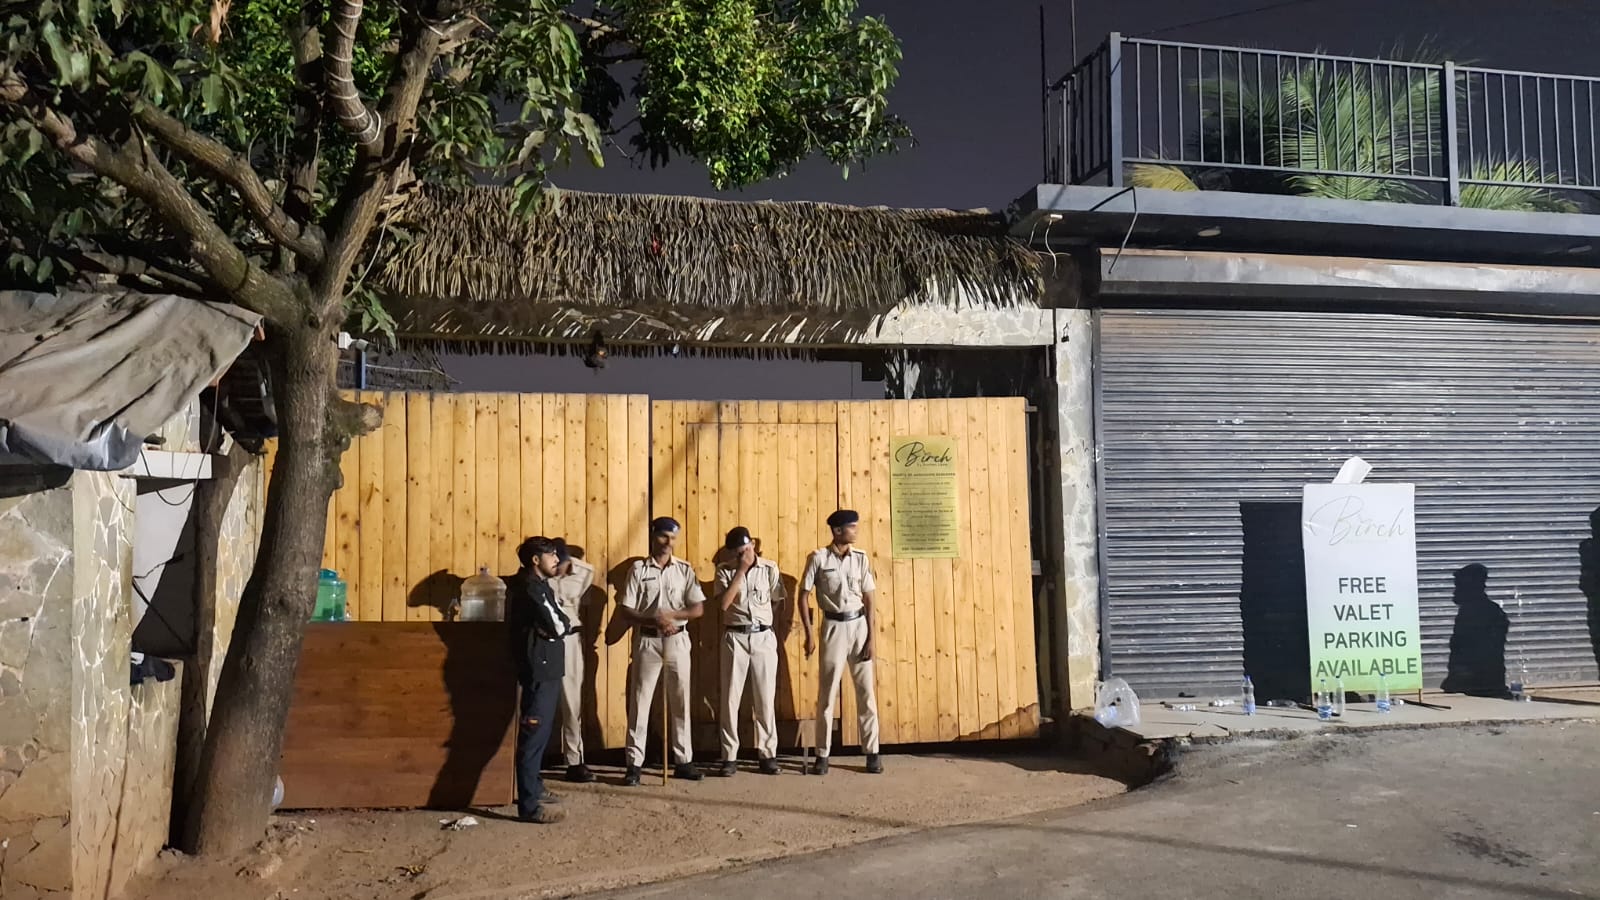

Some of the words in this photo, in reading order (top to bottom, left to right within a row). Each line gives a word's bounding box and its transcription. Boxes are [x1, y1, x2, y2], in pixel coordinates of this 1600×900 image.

[895, 441, 952, 467] Birch
[1309, 495, 1406, 546] Birch
[1338, 577, 1387, 593] FREE
[1333, 604, 1394, 621] VALET
[1324, 631, 1407, 649] PARKING
[1316, 658, 1418, 677] AVAILABLE
